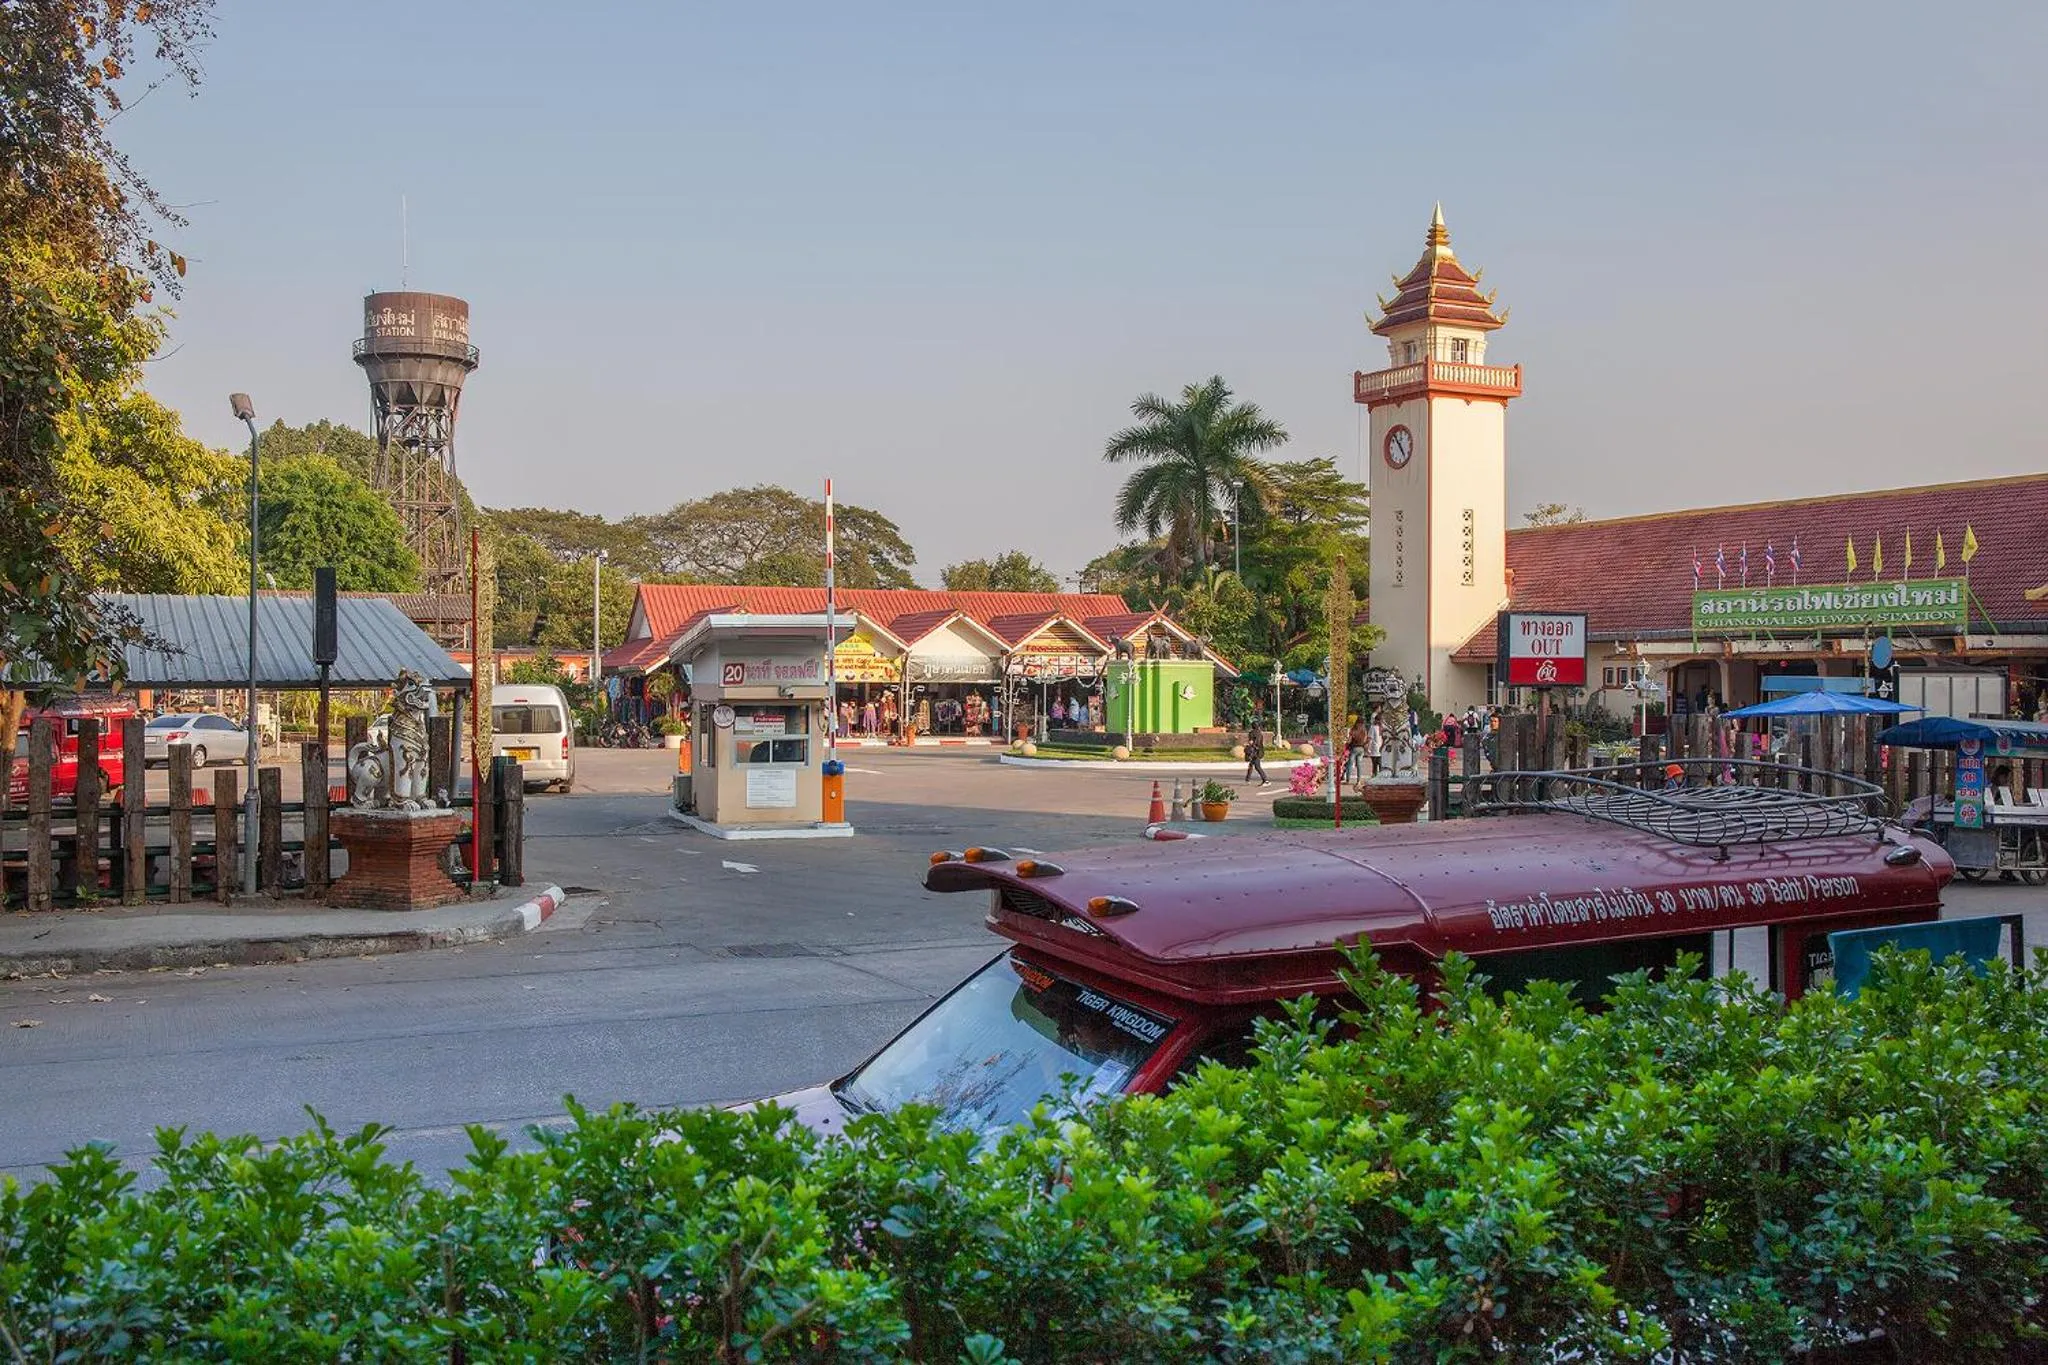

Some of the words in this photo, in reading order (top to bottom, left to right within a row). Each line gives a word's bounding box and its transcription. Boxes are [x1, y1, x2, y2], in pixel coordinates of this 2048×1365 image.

[376, 327, 415, 337] STATION
[1701, 582, 1958, 614] สถานีรถไฟเชียงใหม่
[1699, 616, 1786, 627] CHIANGMAI
[1793, 613, 1868, 625] RAILWAY
[1878, 610, 1958, 622] STATION
[1520, 621, 1574, 636] ทางออก
[1531, 639, 1563, 655] OUT
[725, 665, 743, 682] 20
[1487, 886, 1655, 929] อัตราค่าโดยสารไม่เกิน
[1656, 890, 1677, 913] 30
[1746, 882, 1766, 904] 30
[1766, 874, 1860, 903] Baht/Person
[1076, 990, 1110, 1011] TIGER
[1106, 1004, 1166, 1039] KINGDOM
